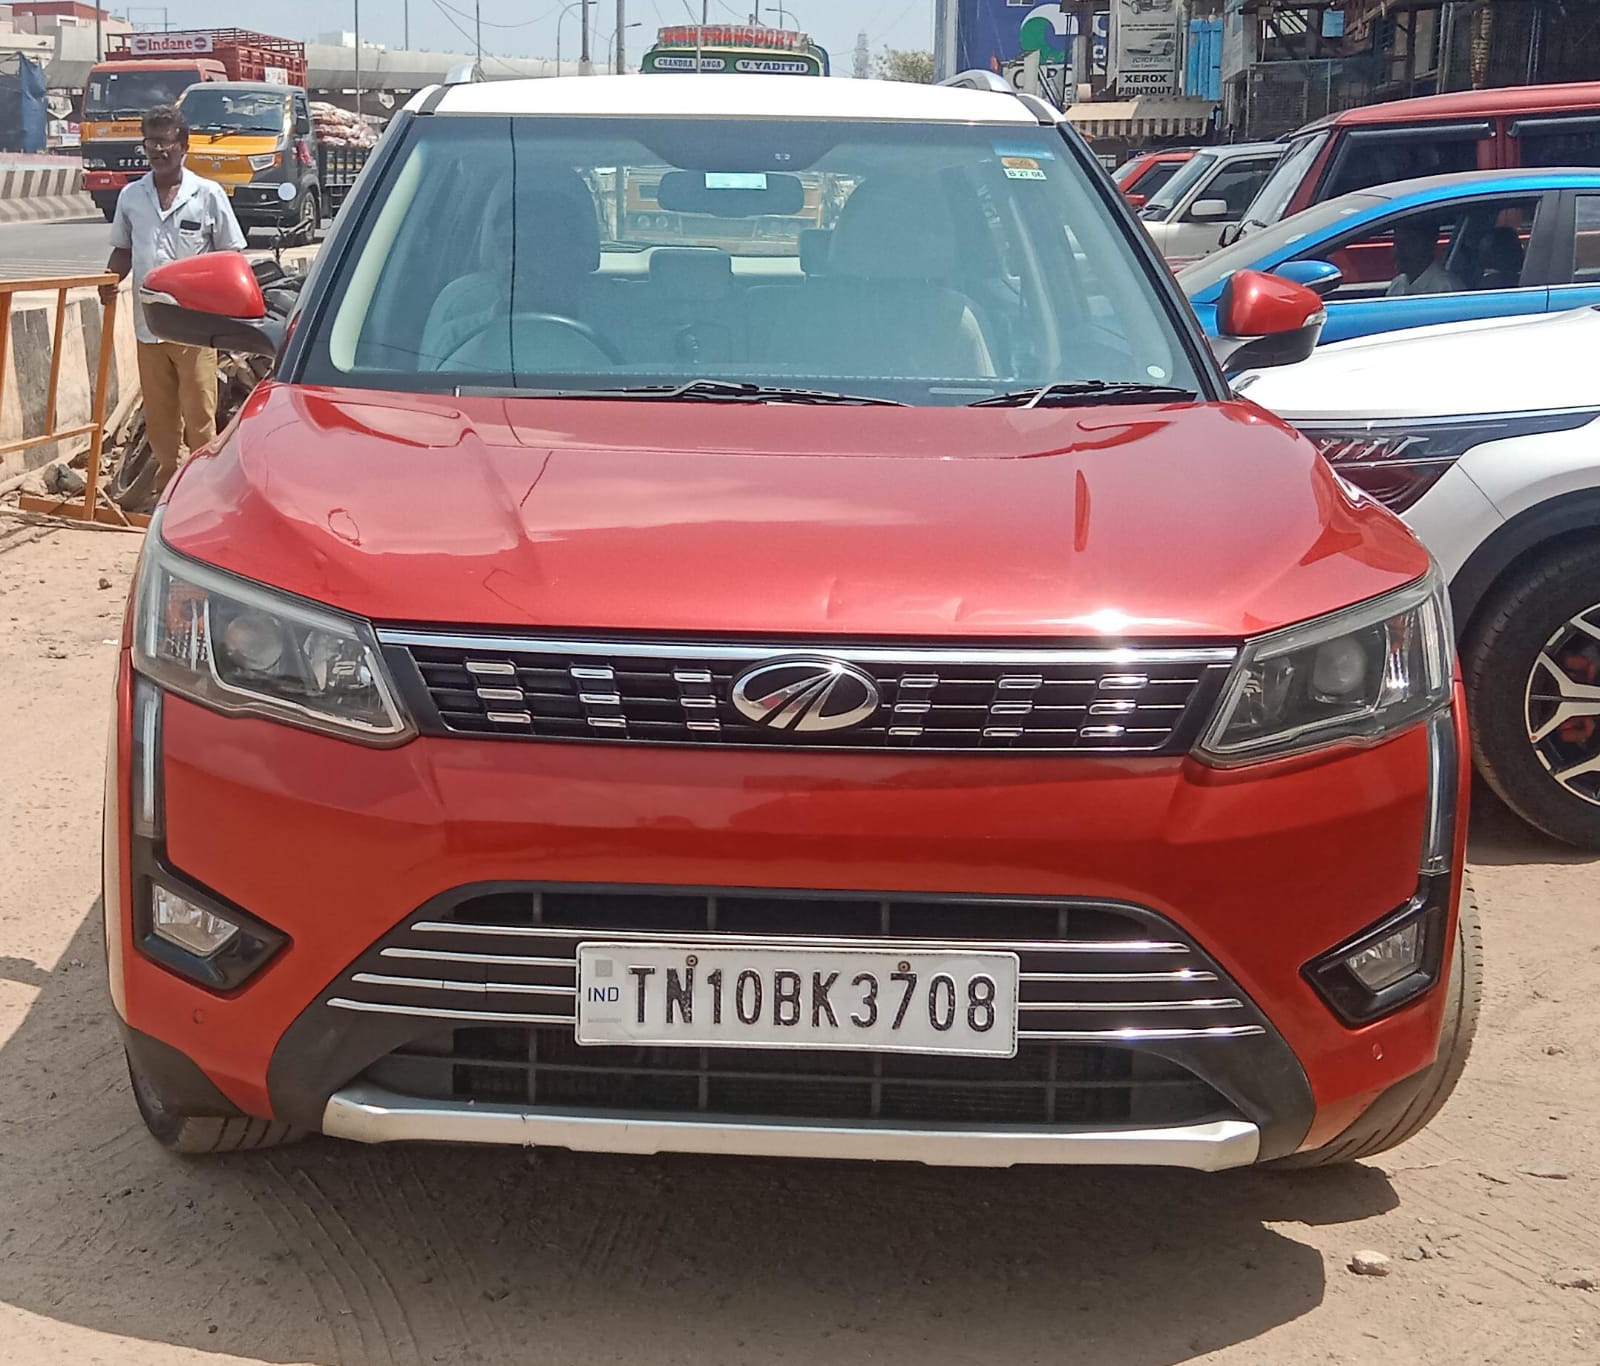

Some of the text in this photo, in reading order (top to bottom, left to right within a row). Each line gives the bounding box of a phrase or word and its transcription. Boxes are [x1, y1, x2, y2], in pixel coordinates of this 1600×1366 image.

[148, 37, 193, 51] Indane
[697, 60, 721, 68] ANGA
[1124, 74, 1167, 83] XEROX
[1118, 86, 1172, 95] PRINTOUT
[588, 986, 619, 1002] IND
[628, 967, 997, 1033] TN10BK3708
